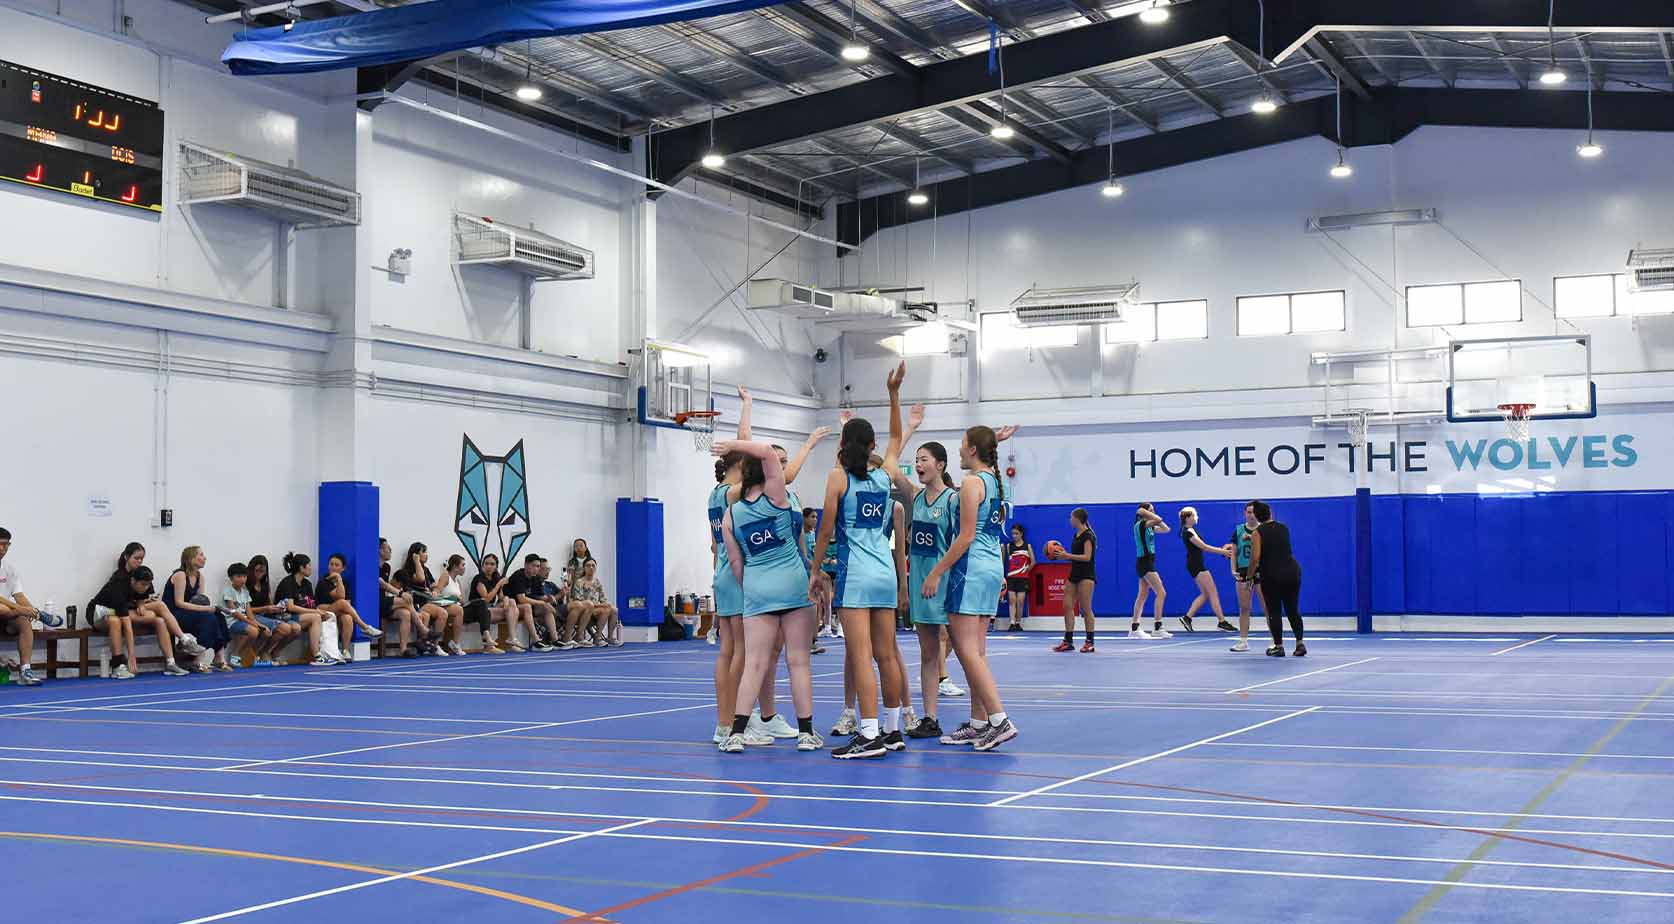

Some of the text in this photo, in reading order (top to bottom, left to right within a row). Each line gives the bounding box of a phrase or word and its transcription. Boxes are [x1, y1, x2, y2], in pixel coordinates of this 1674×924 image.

[1130, 434, 1638, 478] HOME OF THE WOLVES
[861, 503, 882, 517] GK
[750, 529, 774, 545] GA
[915, 531, 933, 546] GS
